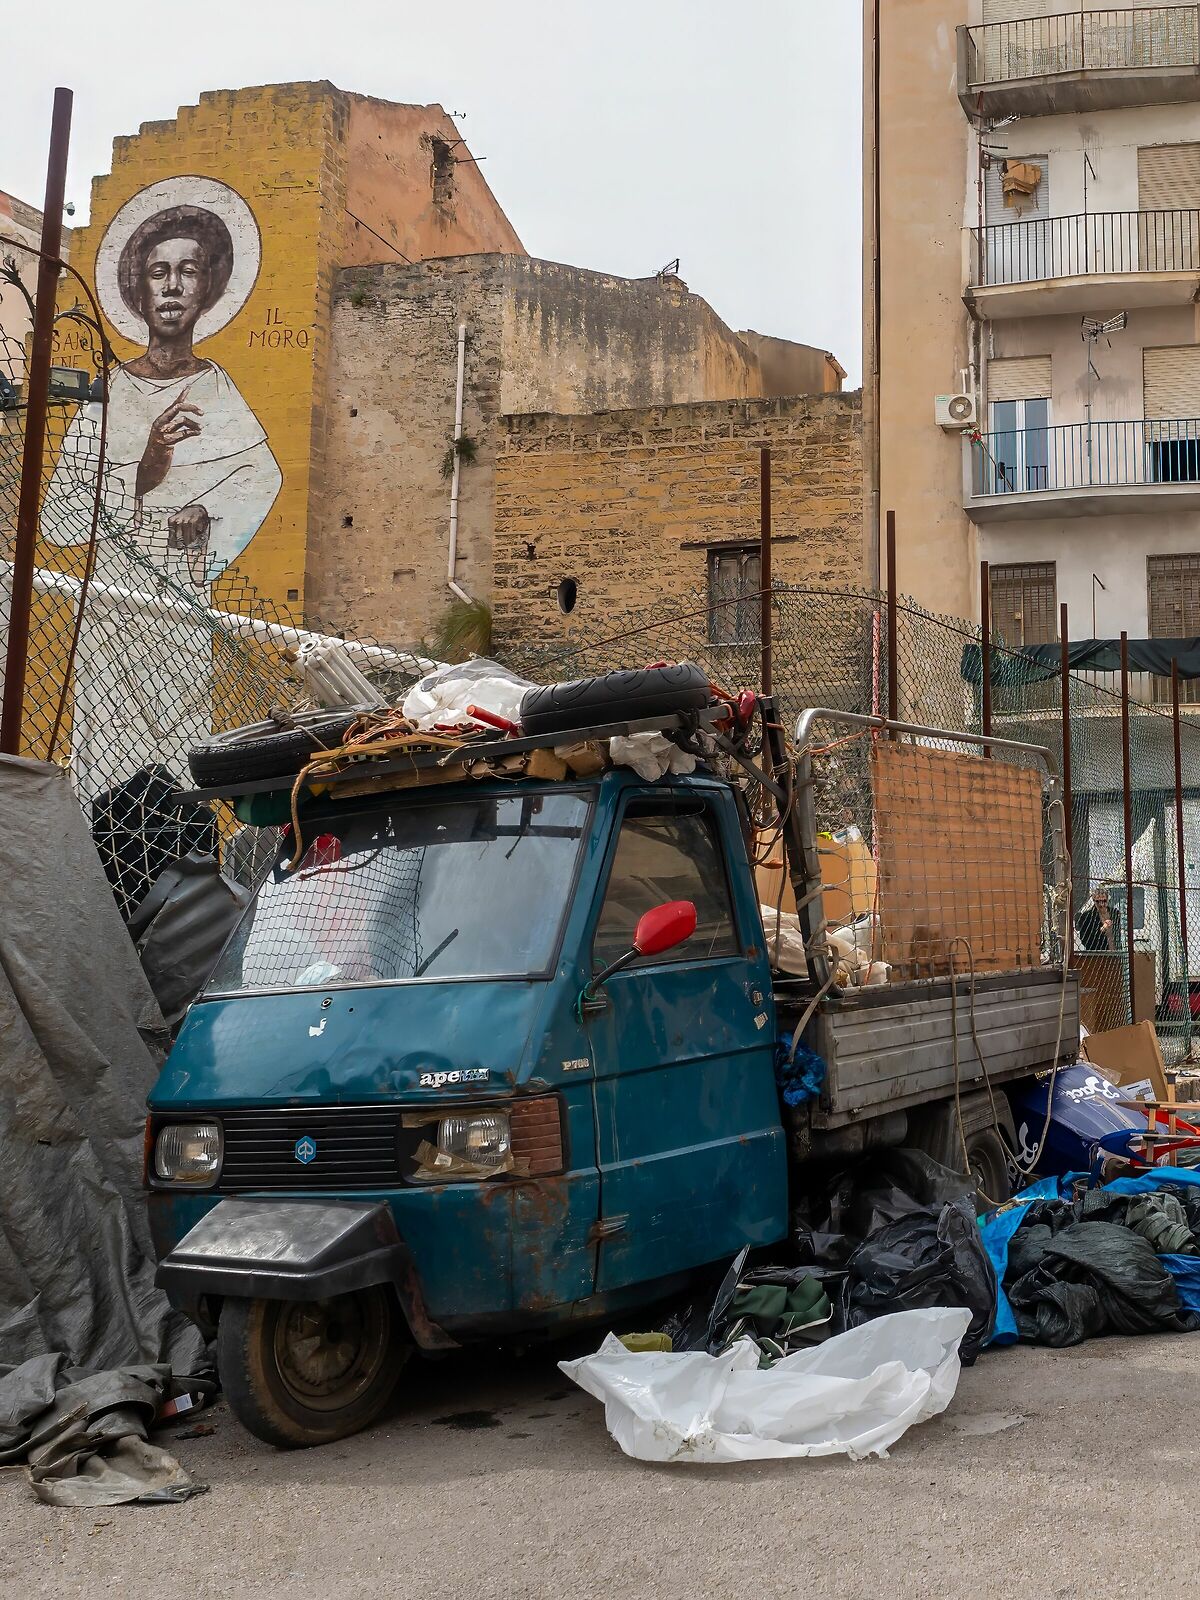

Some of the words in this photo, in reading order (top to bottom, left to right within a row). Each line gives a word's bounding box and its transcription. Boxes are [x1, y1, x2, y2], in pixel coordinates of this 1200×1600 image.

[266, 307, 283, 326] IL
[248, 329, 309, 349] MORO
[1064, 1076, 1120, 1104] Baci
